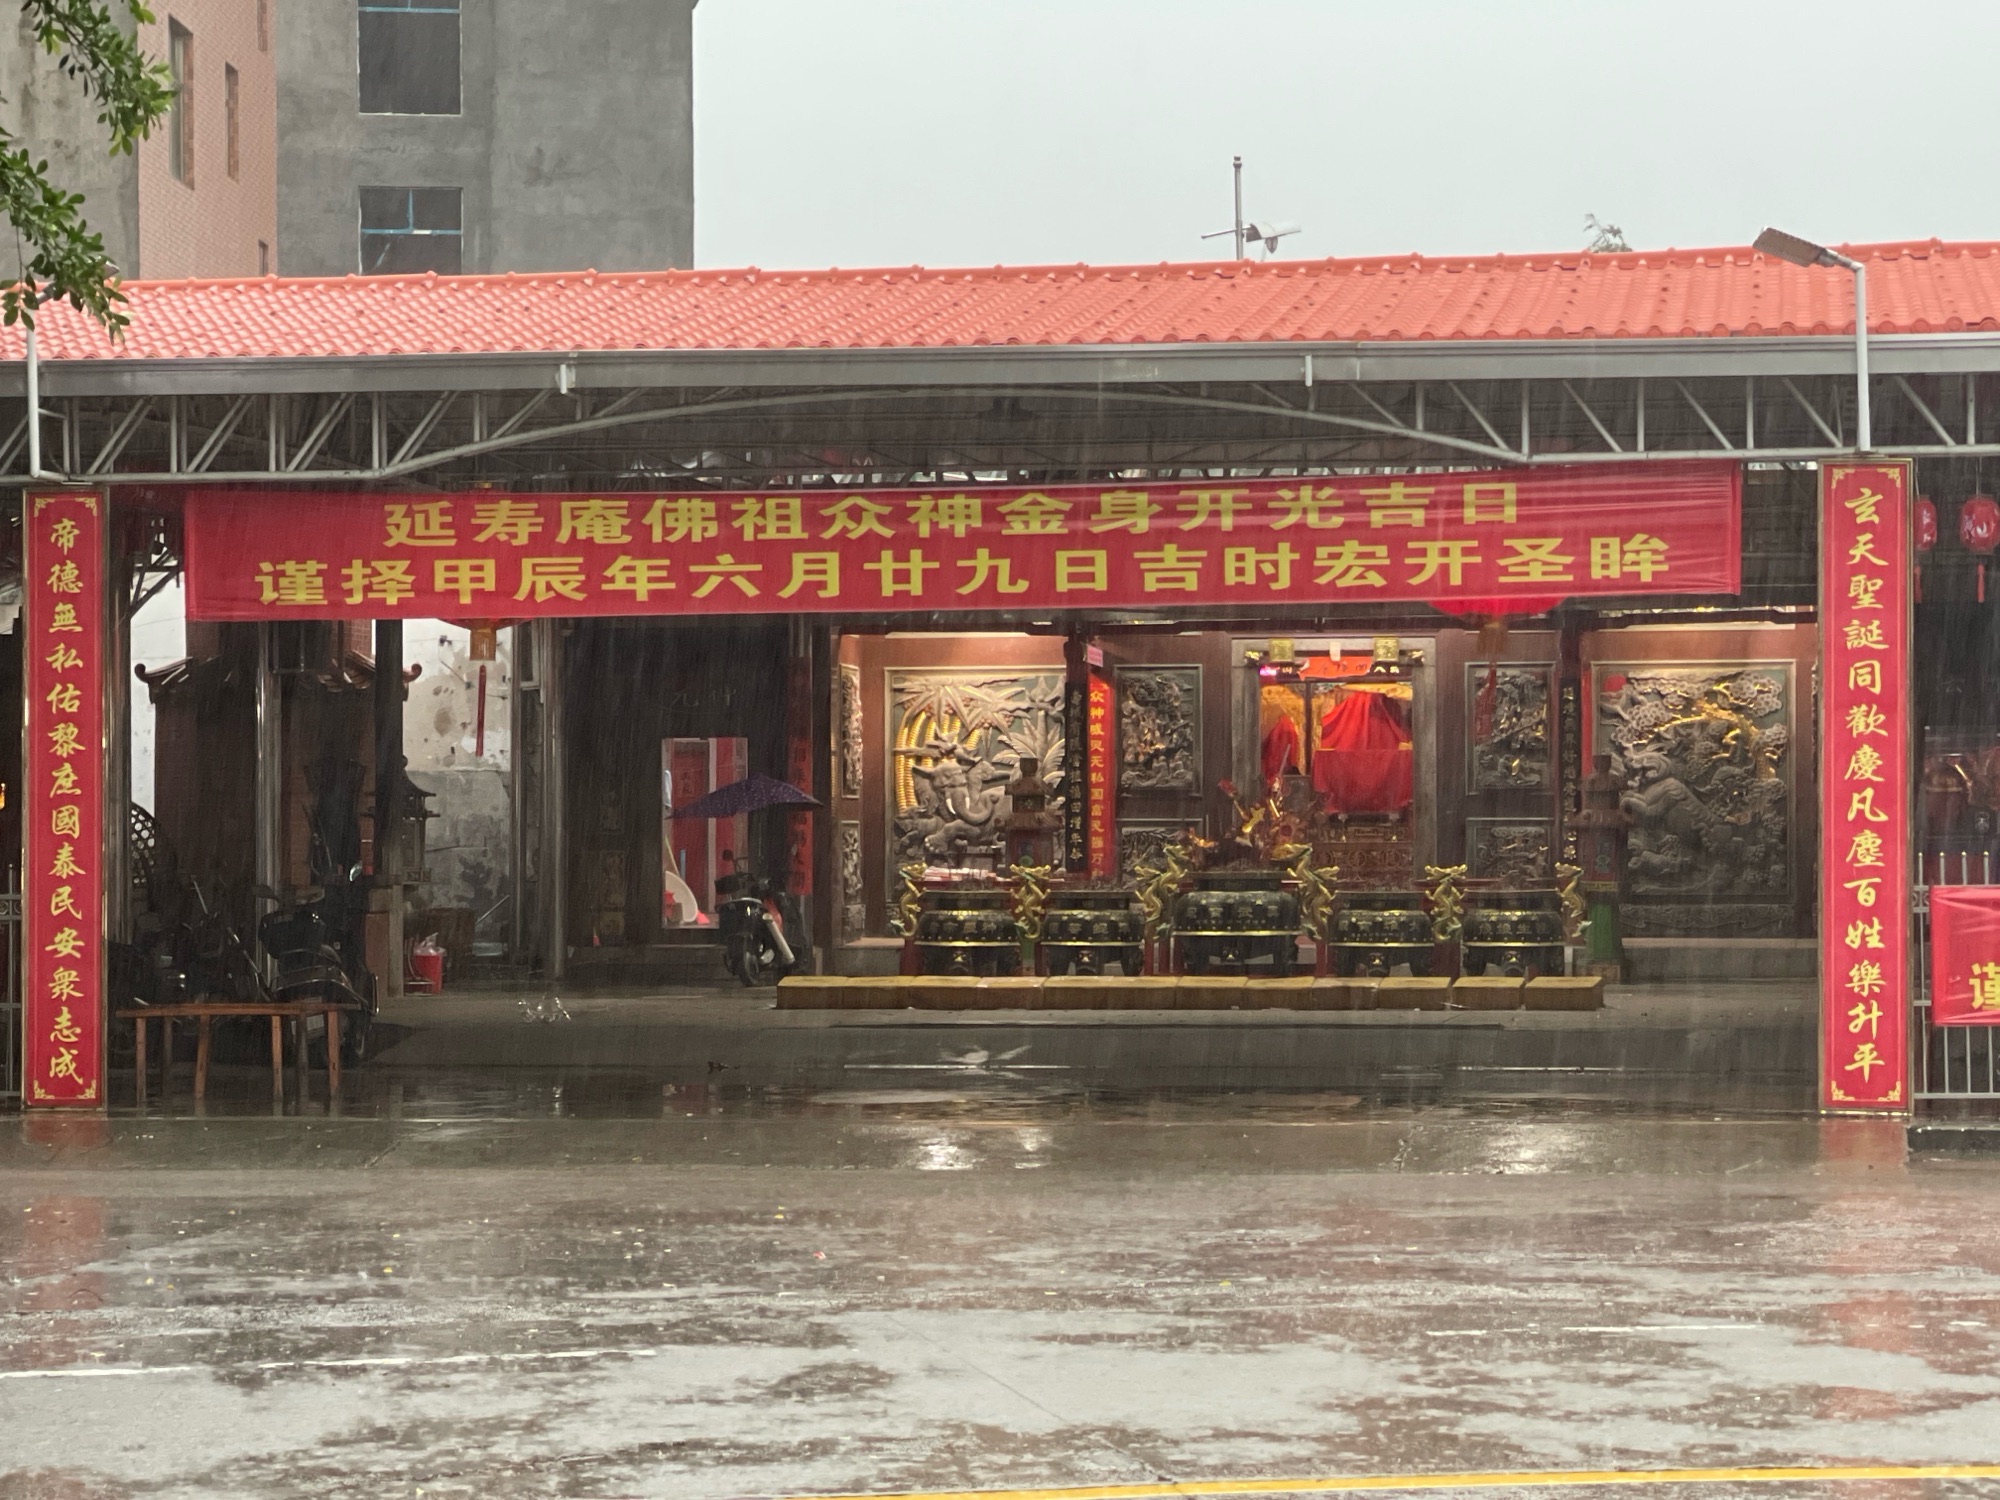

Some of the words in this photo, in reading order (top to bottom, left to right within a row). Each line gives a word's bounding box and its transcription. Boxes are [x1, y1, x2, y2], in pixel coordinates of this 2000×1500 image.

[385, 483, 1518, 546] 延寿庵佛祖众神金身开光吉日
[254, 533, 1671, 605] 谨择甲辰年六月廿九日吉时宏开圣眸
[1843, 487, 1889, 1084] 玄天聖誕同歡慶凡塵百姓樂升平
